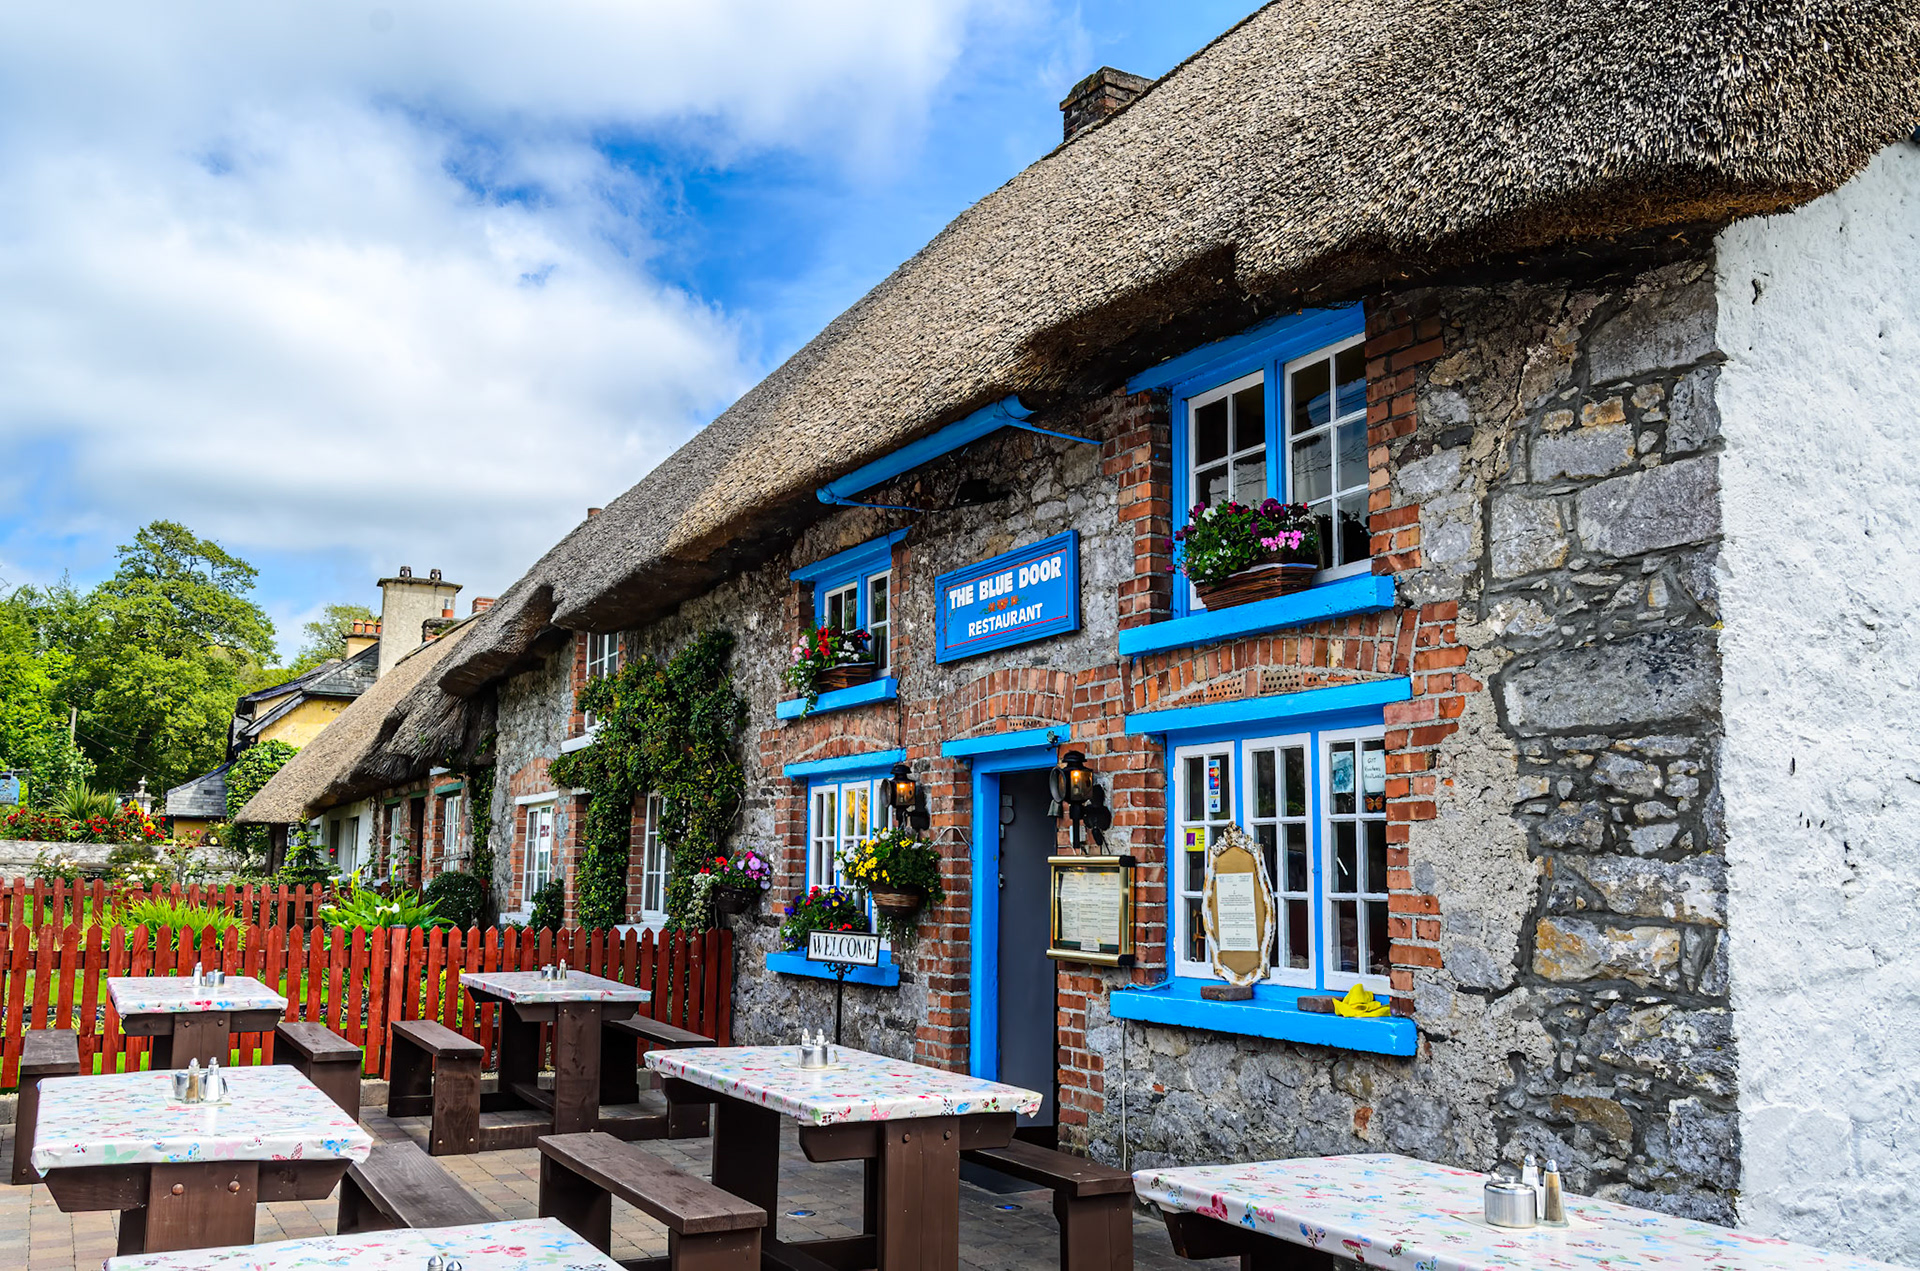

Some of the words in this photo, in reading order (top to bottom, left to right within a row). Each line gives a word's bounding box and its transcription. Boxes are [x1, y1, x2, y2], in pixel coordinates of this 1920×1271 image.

[949, 584, 974, 610] THE
[979, 572, 1013, 601] BLUE
[1018, 556, 1062, 589] DOOR
[968, 602, 1043, 638] RESTAURANT
[813, 935, 876, 960] WELCOME
